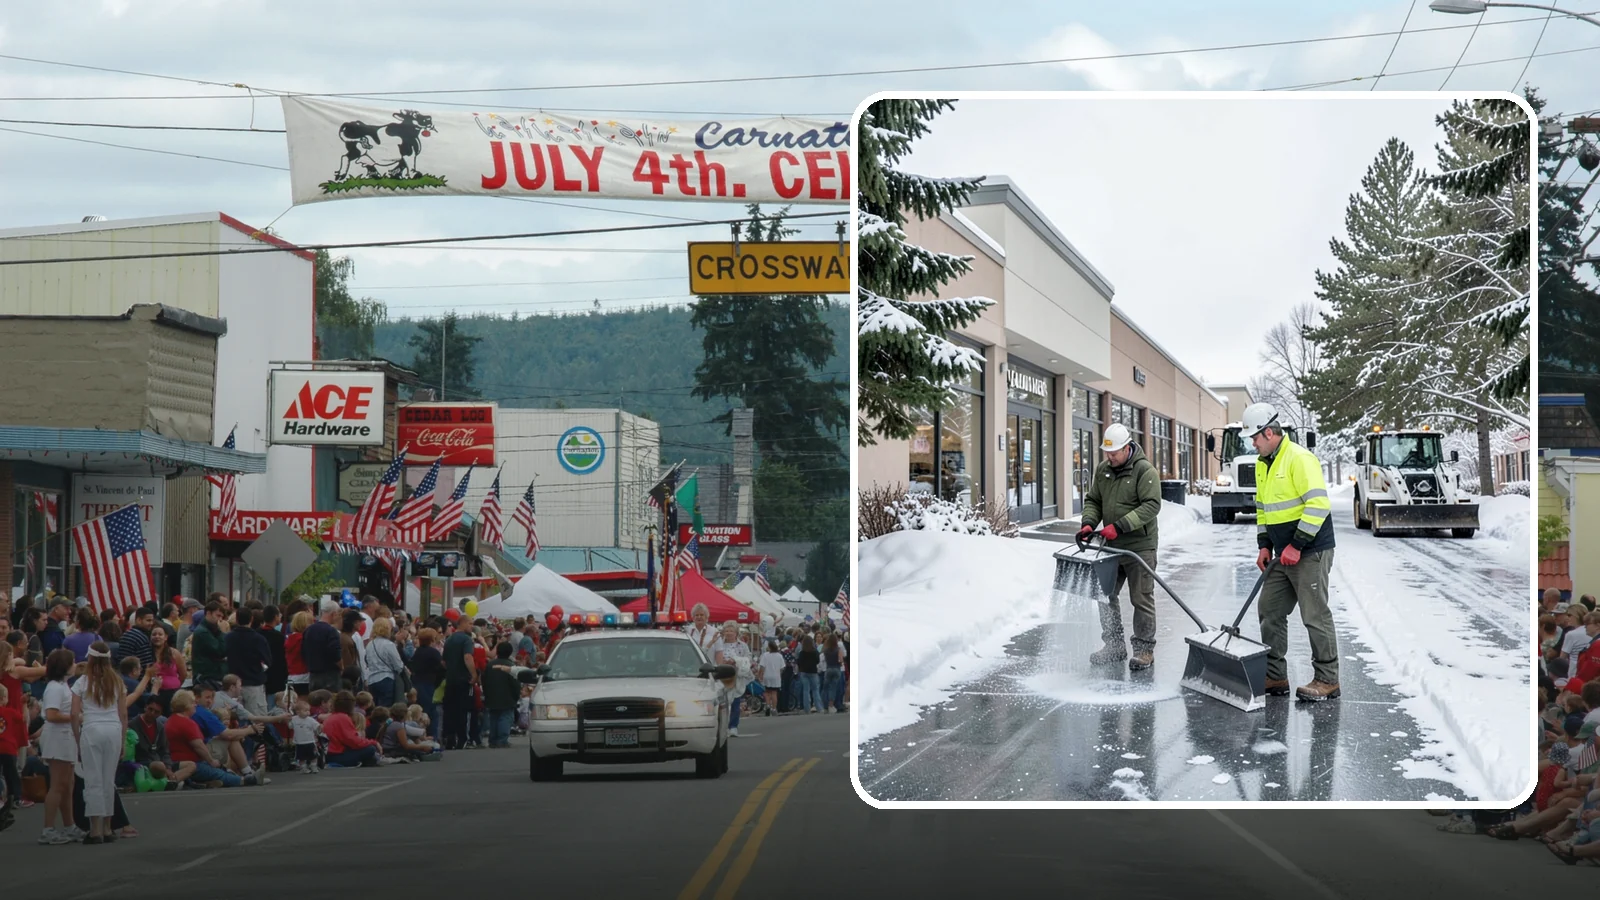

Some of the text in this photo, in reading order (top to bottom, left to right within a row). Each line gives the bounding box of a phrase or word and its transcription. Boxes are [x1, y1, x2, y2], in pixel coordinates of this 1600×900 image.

[694, 120, 850, 150] Carnat
[481, 140, 605, 193] JULY
[632, 150, 747, 198] 4th.
[696, 254, 850, 280] CROSSWA
[282, 380, 374, 420] ACE
[405, 409, 485, 422] CEDAR LOG
[283, 421, 371, 436] Hardware
[416, 428, 477, 447] Coca-Cola
[353, 467, 385, 480] Simpl
[95, 484, 124, 495] Vincent
[126, 485, 136, 495] de
[137, 485, 155, 496] Paul
[81, 503, 154, 522] THT
[688, 526, 741, 535] CRNATION
[699, 535, 730, 543] GLASS
